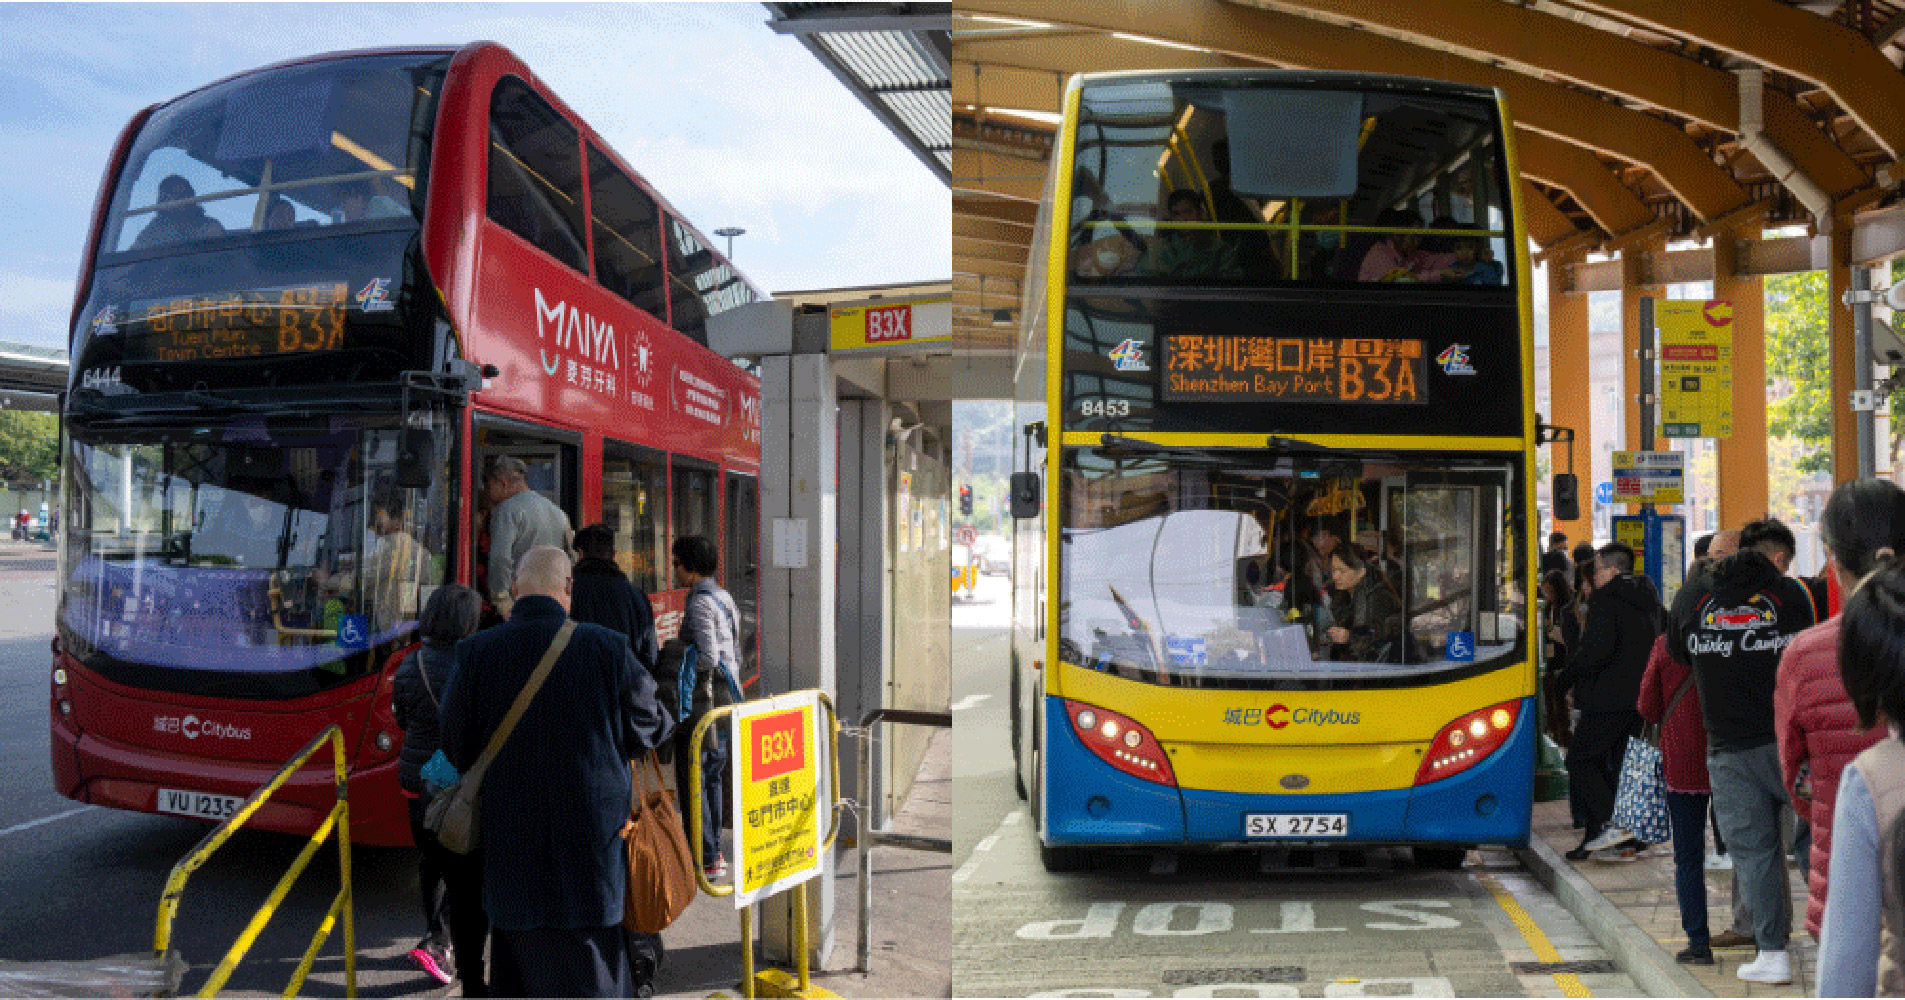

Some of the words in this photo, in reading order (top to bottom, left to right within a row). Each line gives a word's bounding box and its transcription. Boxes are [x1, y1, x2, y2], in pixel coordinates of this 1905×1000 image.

[147, 292, 272, 332] 屯門市中心
[278, 302, 346, 353] B3X
[534, 287, 619, 370] MAIYA
[869, 309, 909, 340] B3X
[1167, 335, 1334, 373] 深圳灣口岸
[83, 366, 121, 388] 6444
[1169, 373, 1249, 392] Shenzhen
[1254, 373, 1289, 396] Bay
[1293, 374, 1333, 394] Port
[1339, 357, 1416, 401] B3A
[1081, 399, 1130, 416] 8453
[201, 720, 251, 739] Citybus
[1222, 707, 1262, 726] 城巴
[1292, 707, 1361, 726] Citybus
[761, 727, 798, 765] B3X
[167, 791, 190, 811] VU
[195, 795, 235, 818] 1235
[748, 793, 813, 828] 屯門市中心
[1251, 817, 1277, 833] SX
[1288, 817, 1344, 833] 2754
[1015, 900, 1462, 939] STOP
